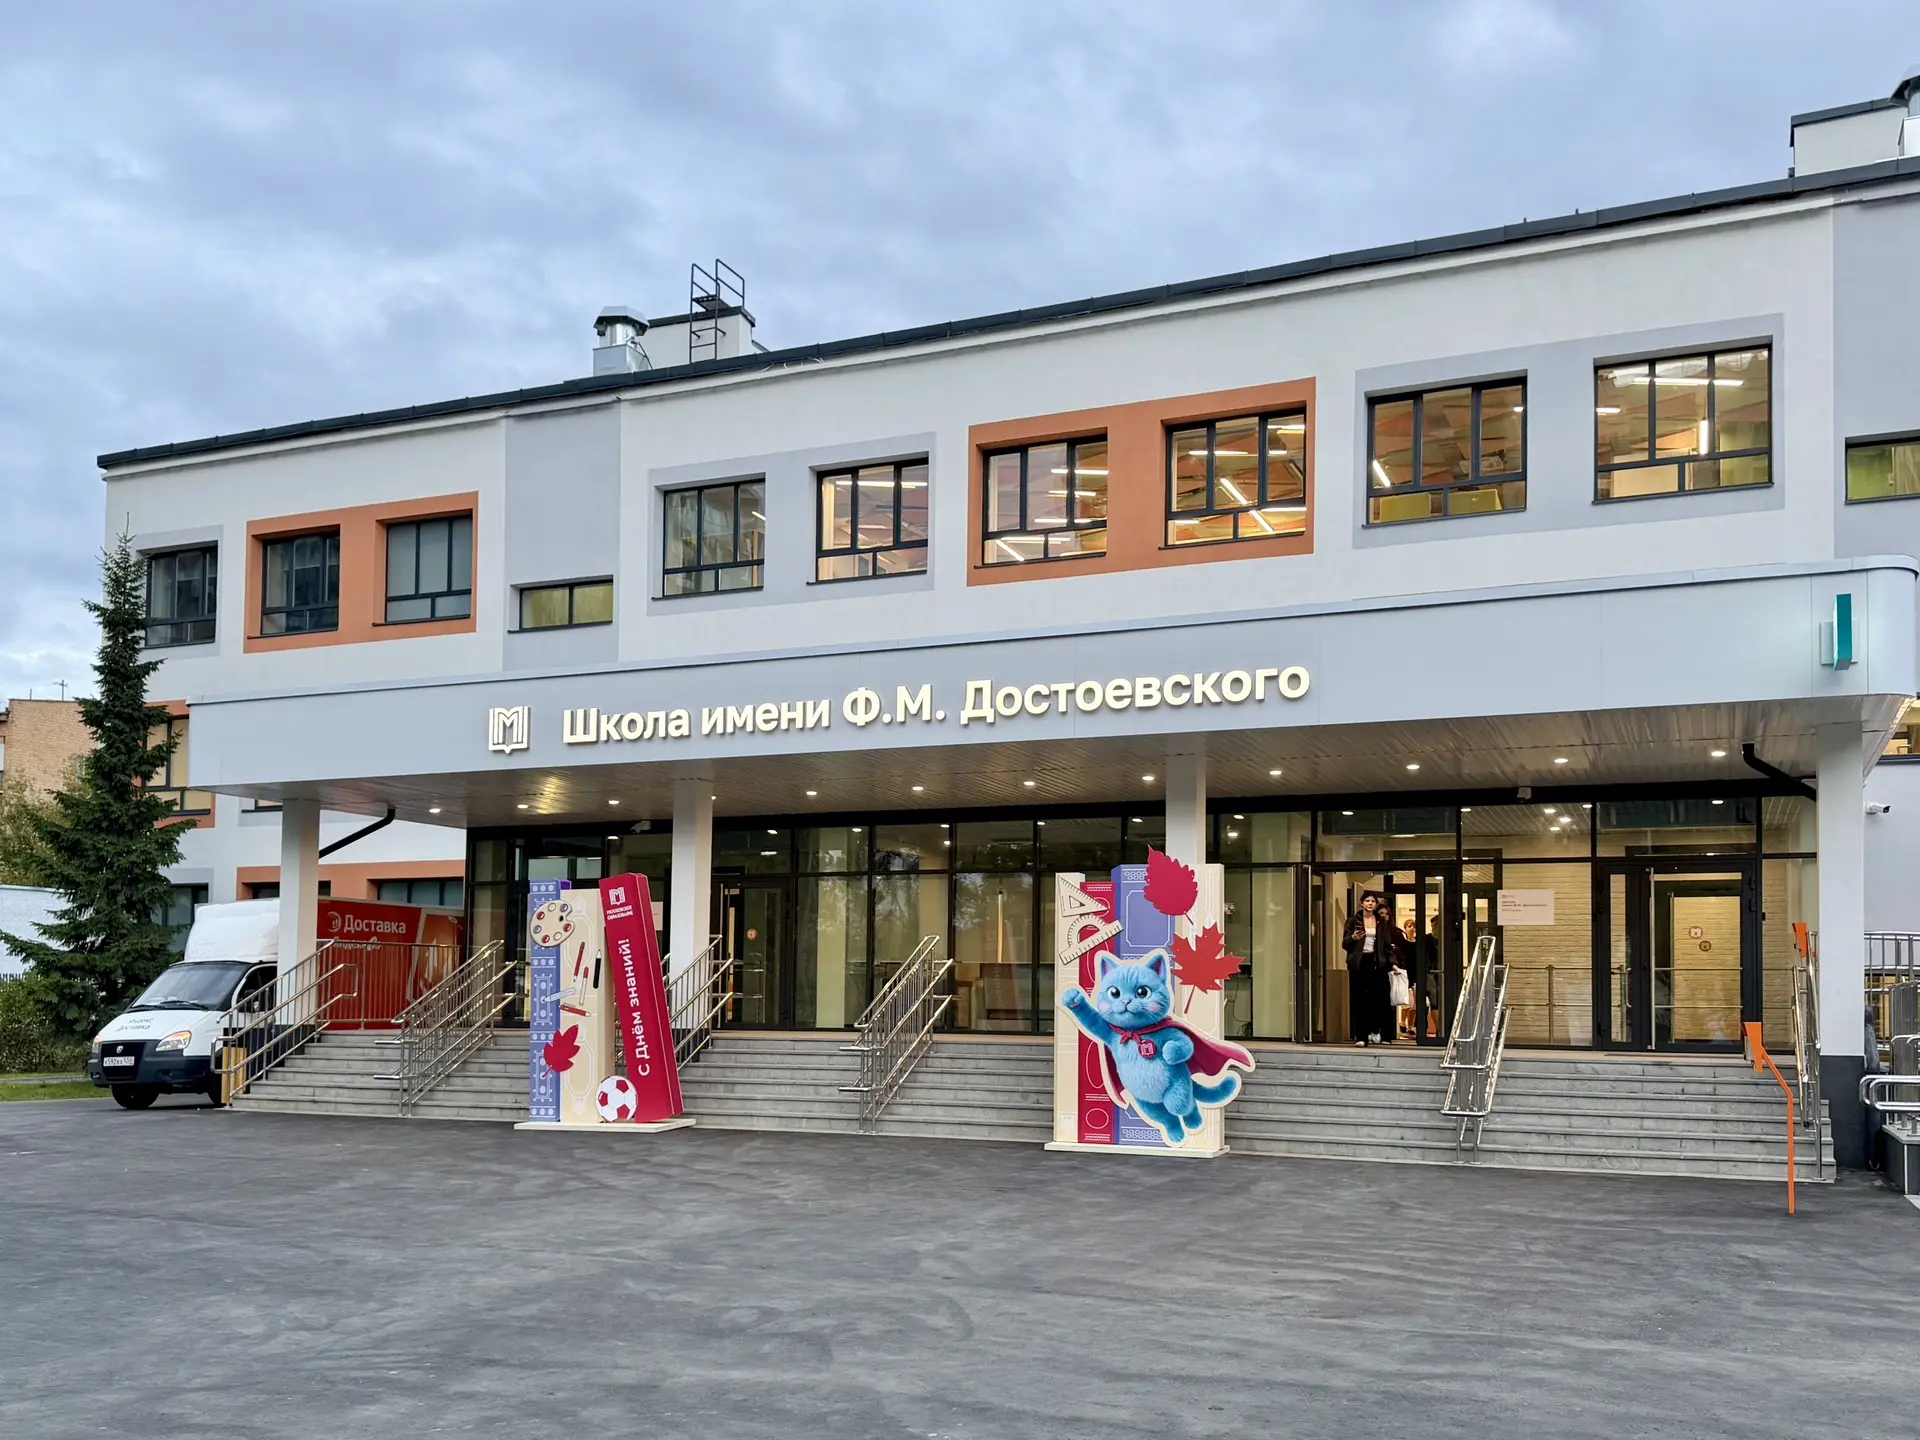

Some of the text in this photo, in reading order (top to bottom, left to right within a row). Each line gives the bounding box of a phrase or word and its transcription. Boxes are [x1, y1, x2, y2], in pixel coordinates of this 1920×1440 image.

[563, 666, 1311, 744] Школа имени Ф.М. Достоевского
[343, 914, 407, 934] Доставка
[617, 938, 640, 1007] знаний!
[631, 1011, 650, 1060] Днём
